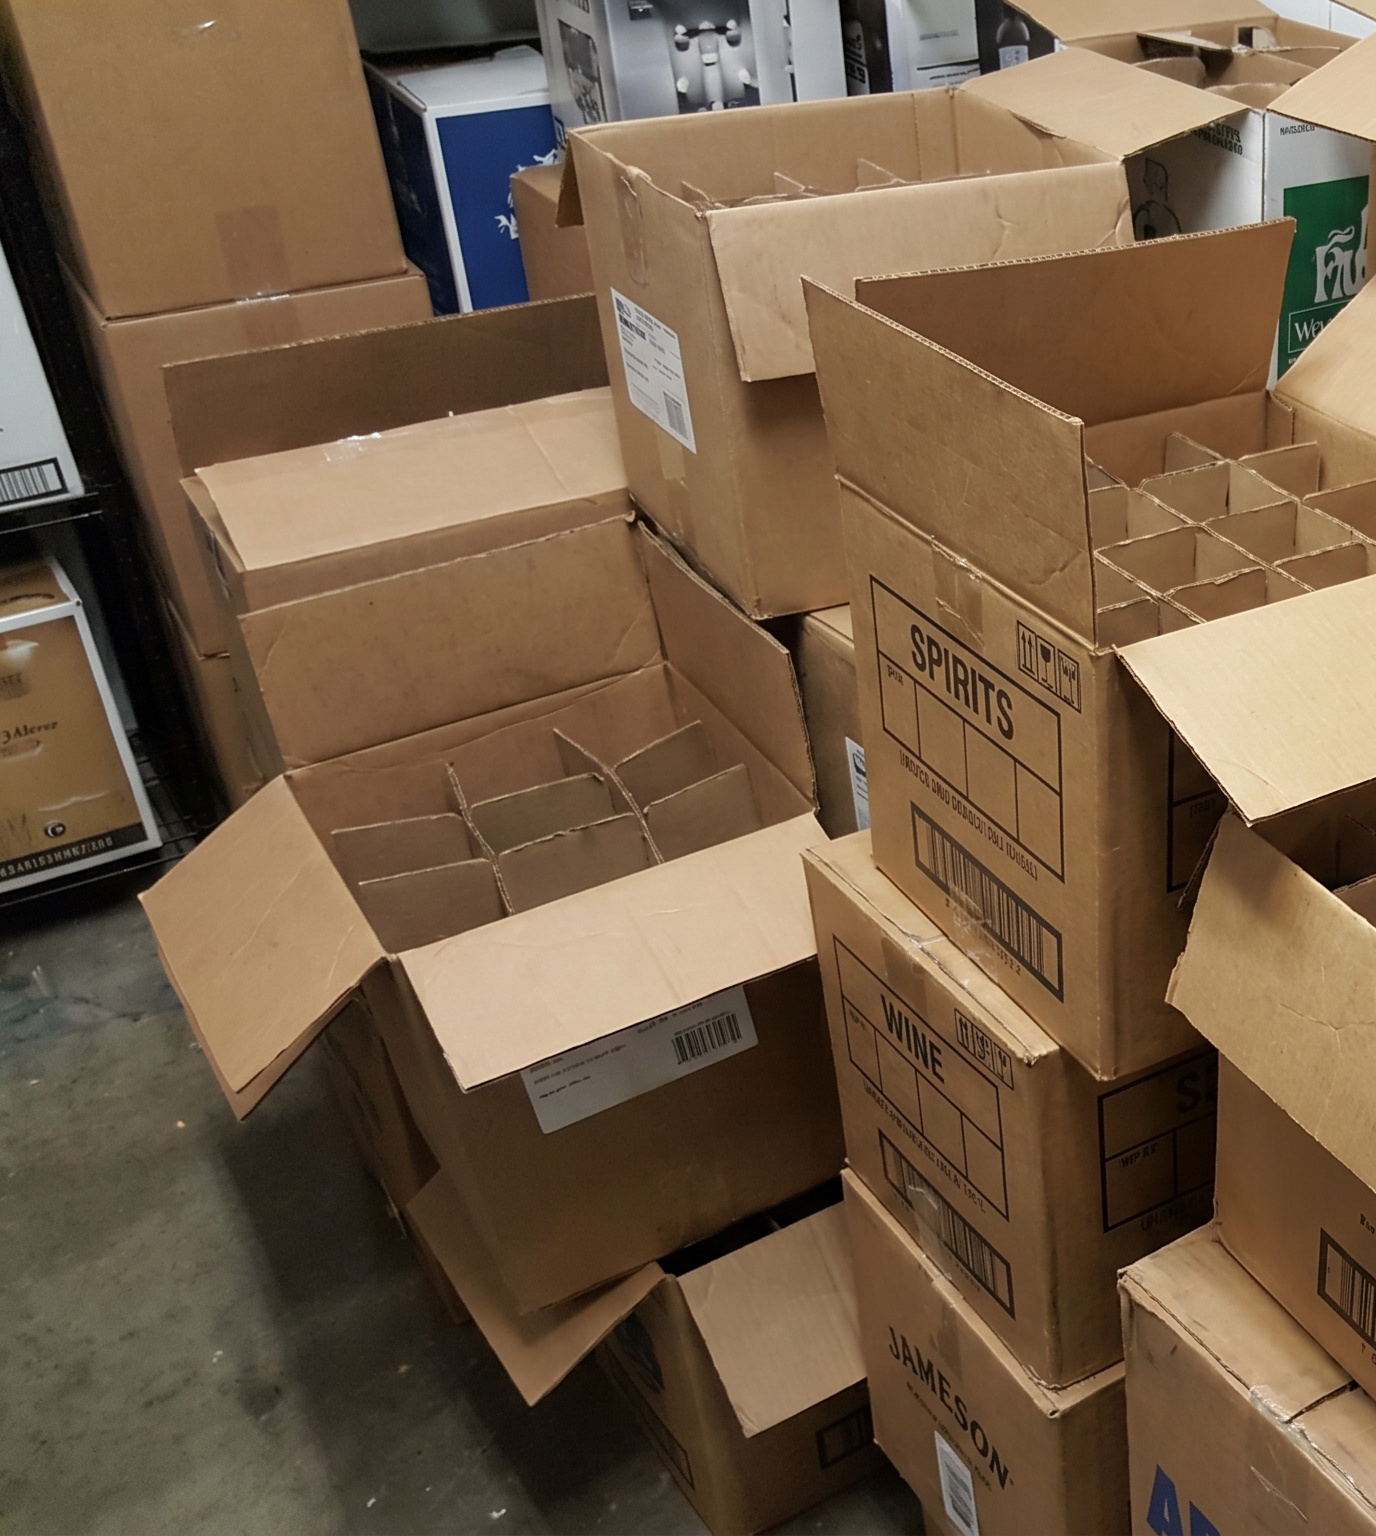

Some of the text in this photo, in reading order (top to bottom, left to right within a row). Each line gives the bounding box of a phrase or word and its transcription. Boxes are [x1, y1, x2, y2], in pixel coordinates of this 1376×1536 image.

[911, 624, 1014, 741] SPIRITS
[881, 994, 945, 1084] WINE
[888, 1326, 1010, 1491] JAMESON
